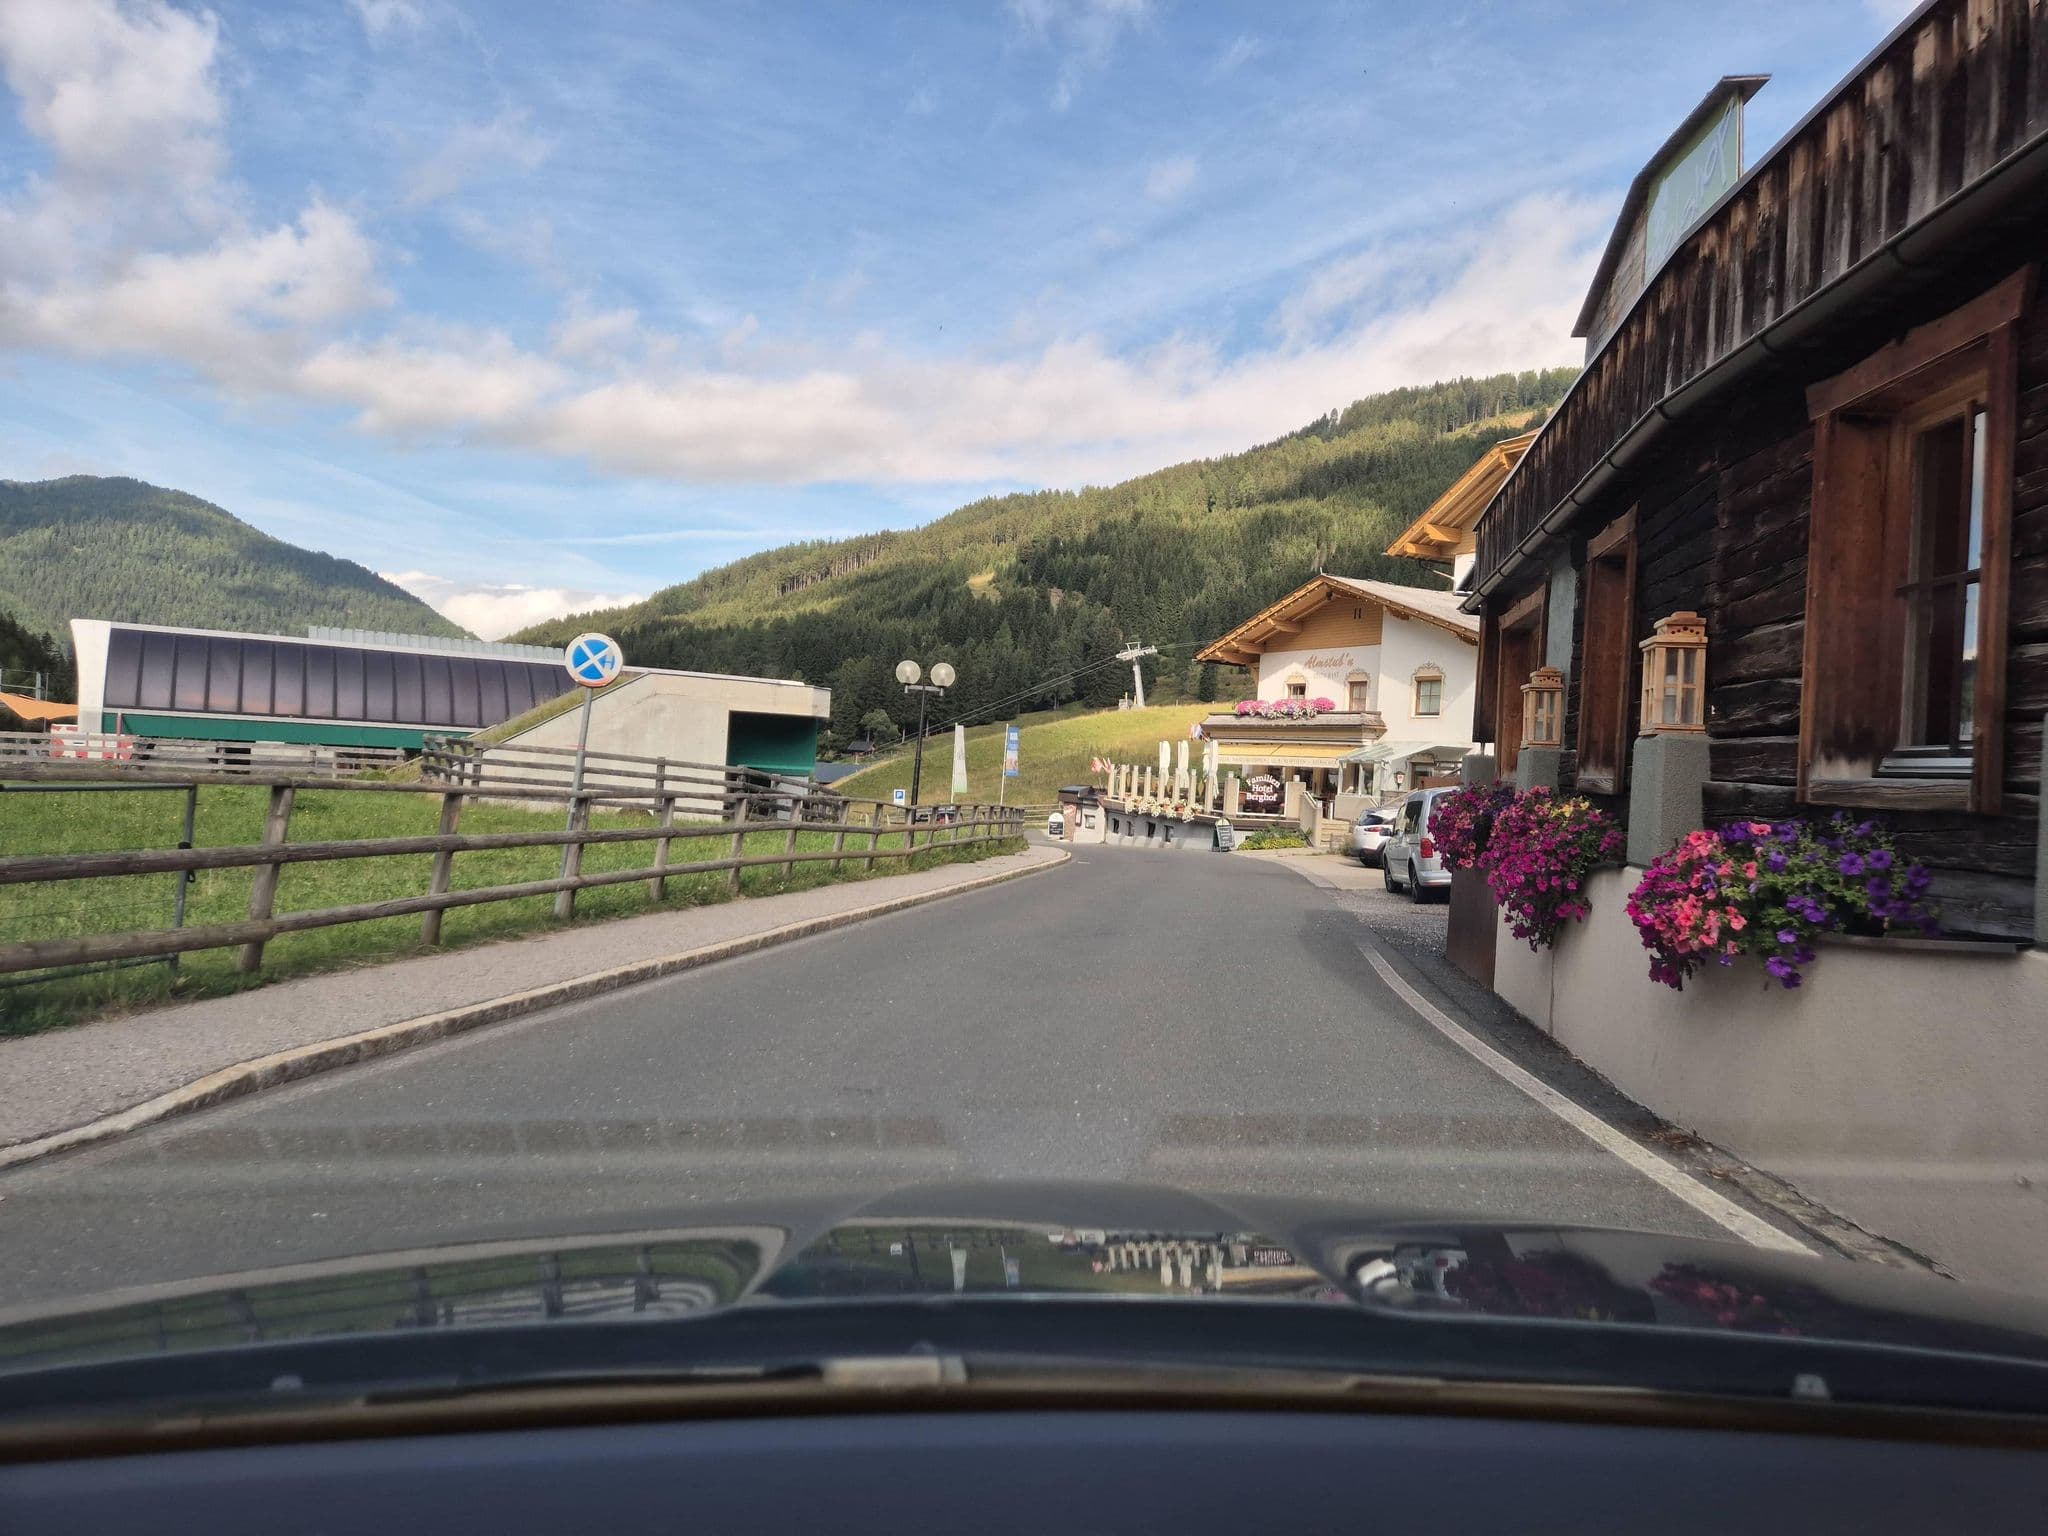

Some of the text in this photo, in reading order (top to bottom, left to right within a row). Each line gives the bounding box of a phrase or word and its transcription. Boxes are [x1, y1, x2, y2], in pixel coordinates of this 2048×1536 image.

[1246, 774, 1280, 788] Familien
[1252, 784, 1273, 792] Hotel
[1246, 792, 1278, 802] Berghof
